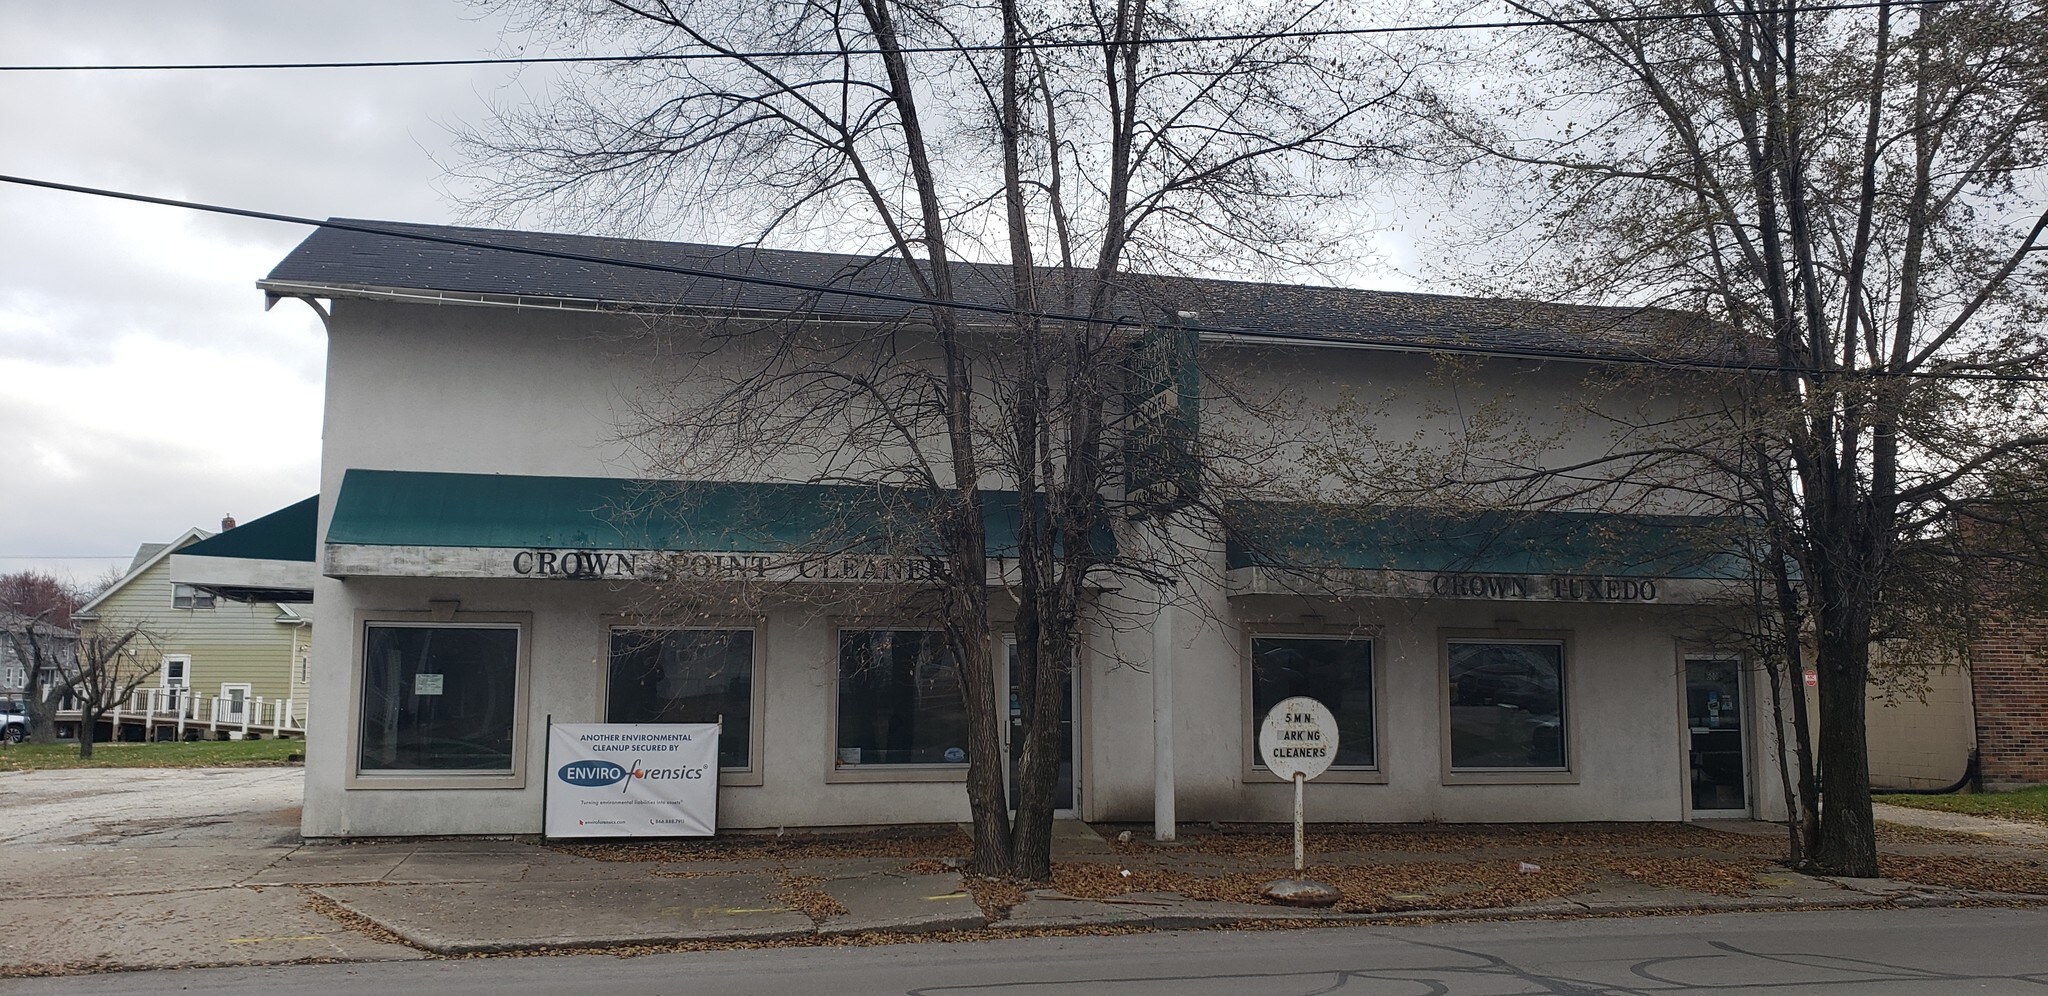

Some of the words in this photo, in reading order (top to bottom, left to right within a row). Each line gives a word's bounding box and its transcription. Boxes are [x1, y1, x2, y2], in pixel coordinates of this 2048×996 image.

[513, 551, 637, 577] CROWN
[671, 554, 771, 578] POINT
[800, 556, 953, 581] CLEANER
[1432, 575, 1528, 597] CROWN
[1551, 577, 1657, 601] TUXEDO
[580, 734, 620, 742] ANOTHER
[622, 734, 692, 742] ENVIRONMENTAL
[592, 744, 630, 752] CLEANUP
[632, 744, 668, 752] SECURED
[669, 744, 680, 752] BY
[1273, 748, 1326, 758] CLEANERS
[581, 799, 599, 807] Turning
